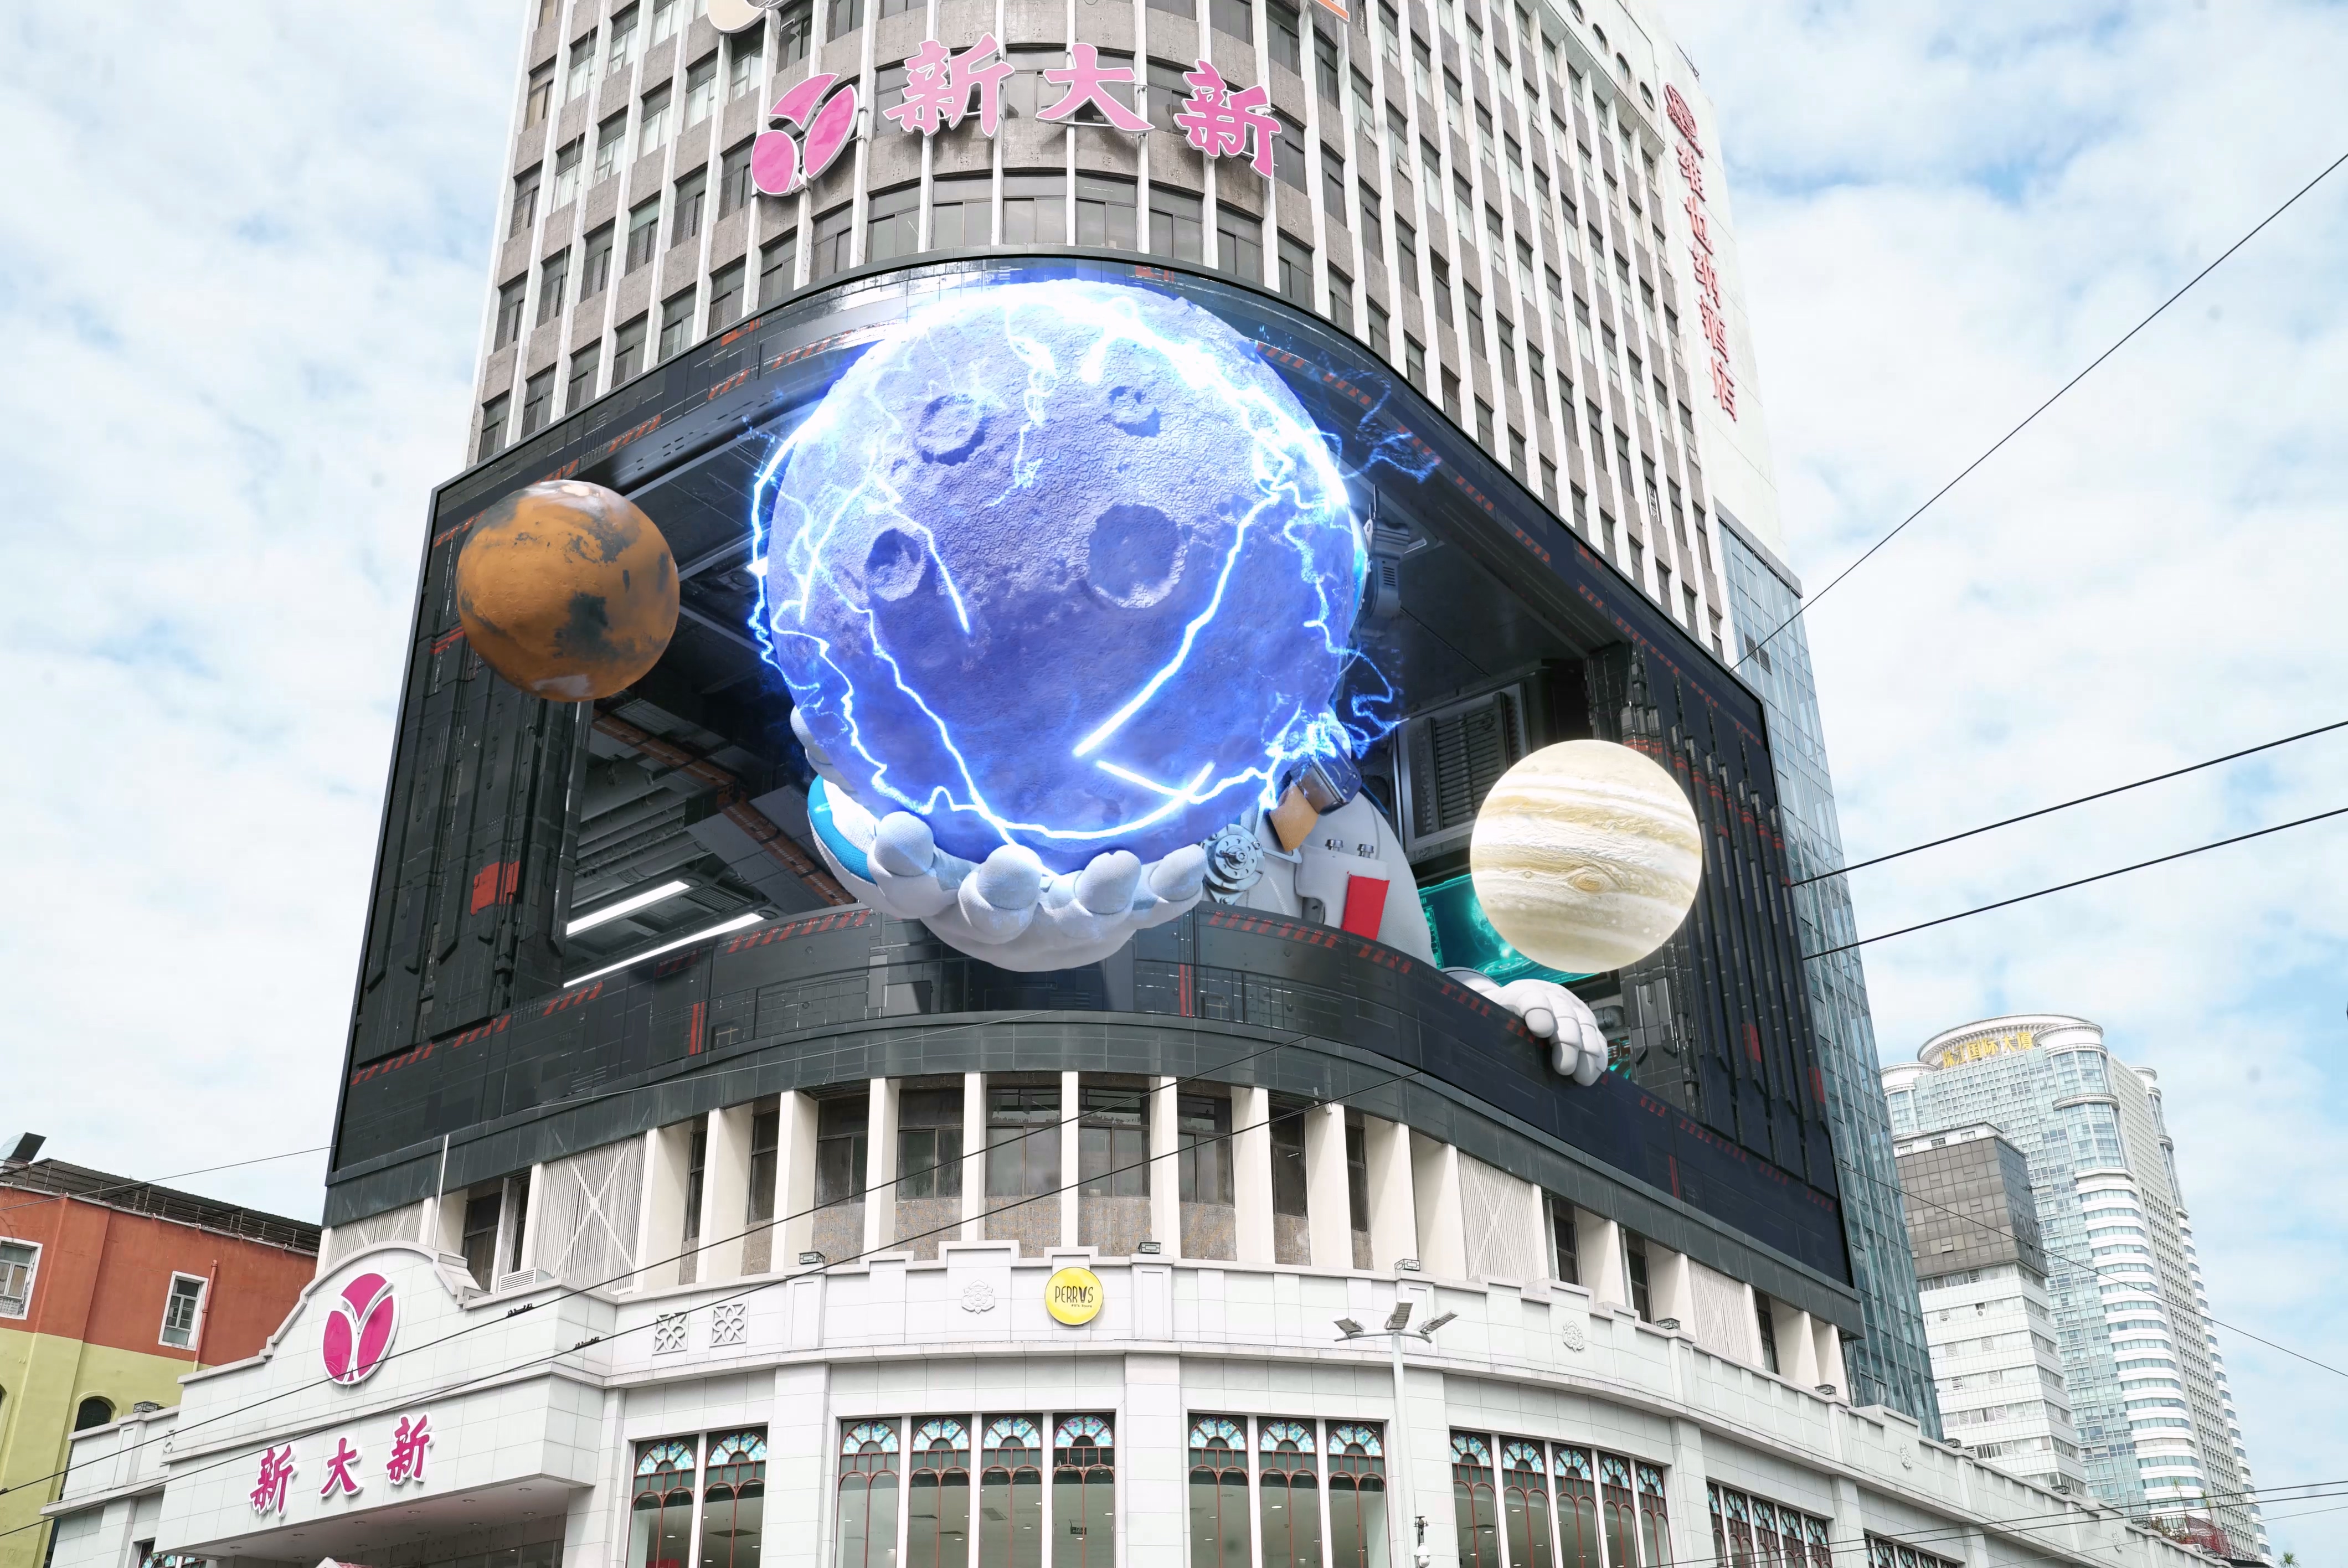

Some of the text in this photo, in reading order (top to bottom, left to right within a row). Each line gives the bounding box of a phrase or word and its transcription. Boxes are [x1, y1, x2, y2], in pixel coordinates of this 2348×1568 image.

[883, 32, 1283, 180] 新大新
[1676, 138, 1738, 421] 维也纳酒店
[1942, 1031, 2033, 1069] 珠江国际大厦
[250, 1413, 432, 1516] 新大新
